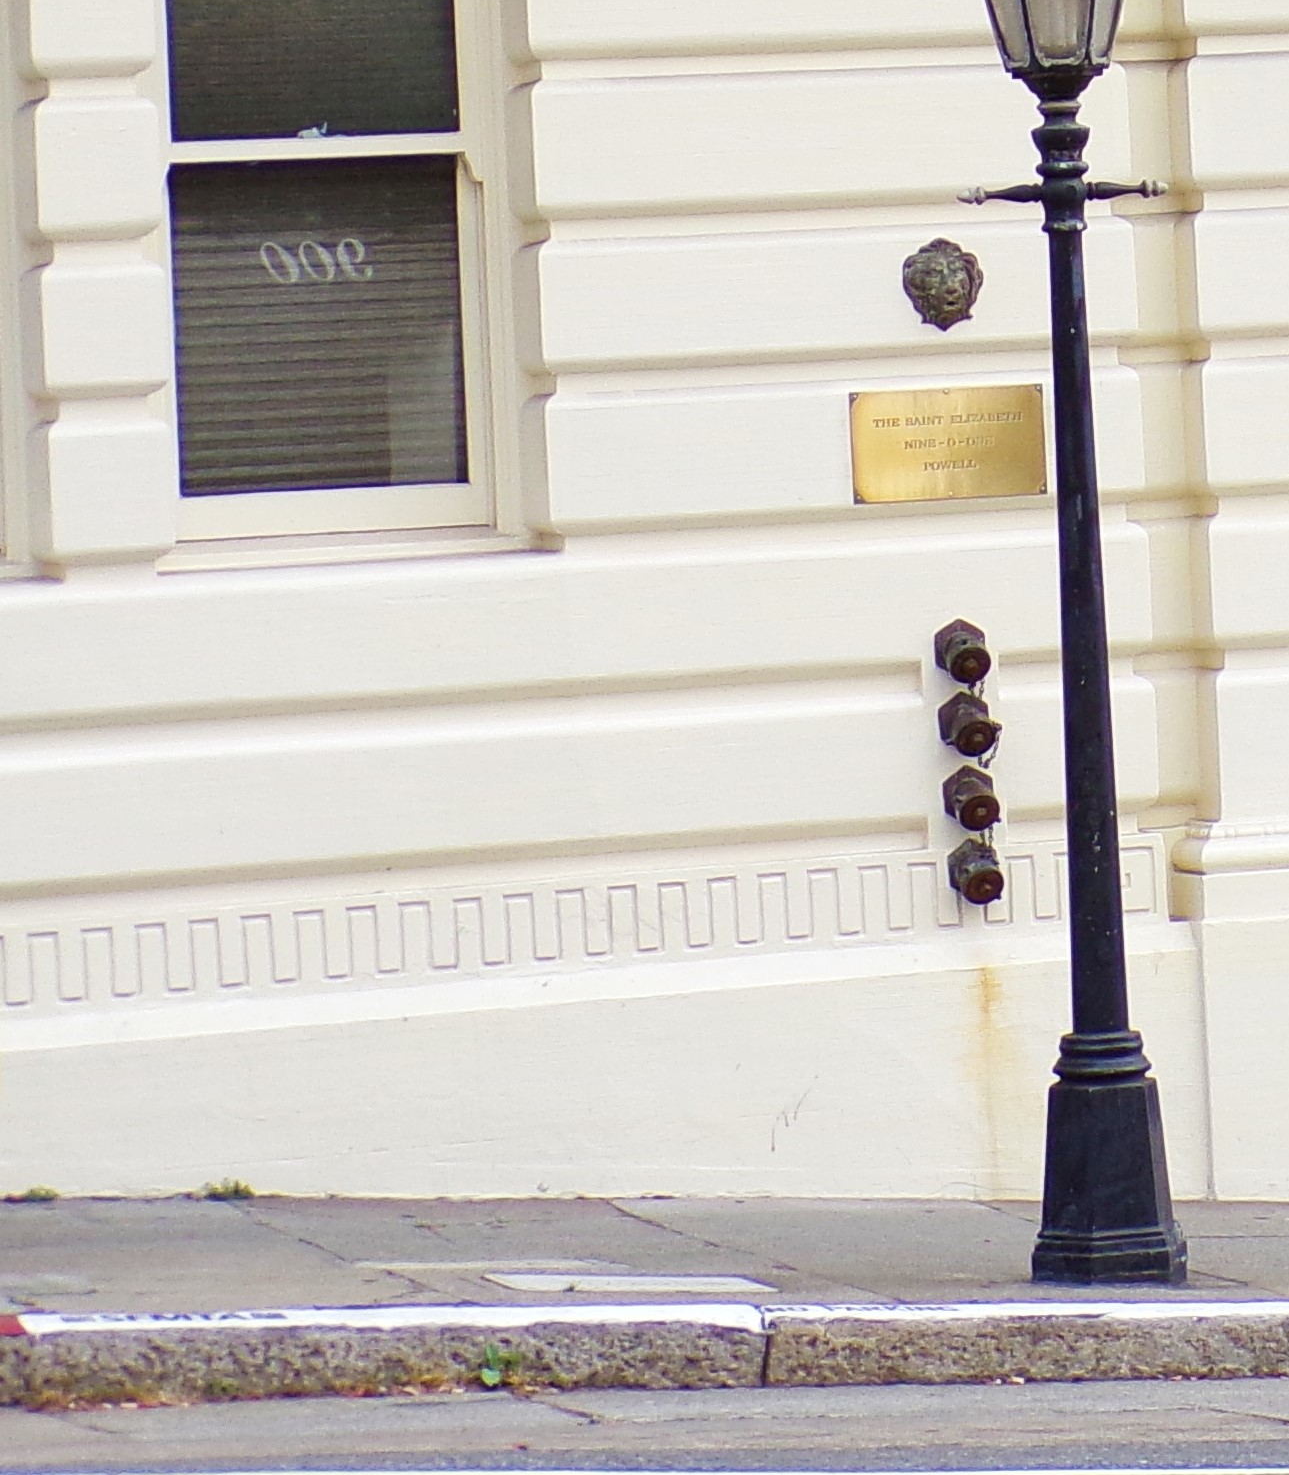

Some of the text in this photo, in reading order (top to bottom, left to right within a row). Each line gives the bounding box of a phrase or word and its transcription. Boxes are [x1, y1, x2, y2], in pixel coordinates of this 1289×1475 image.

[873, 411, 1022, 428] THE SAINT ELIZABETH
[923, 459, 977, 472] POWELL
